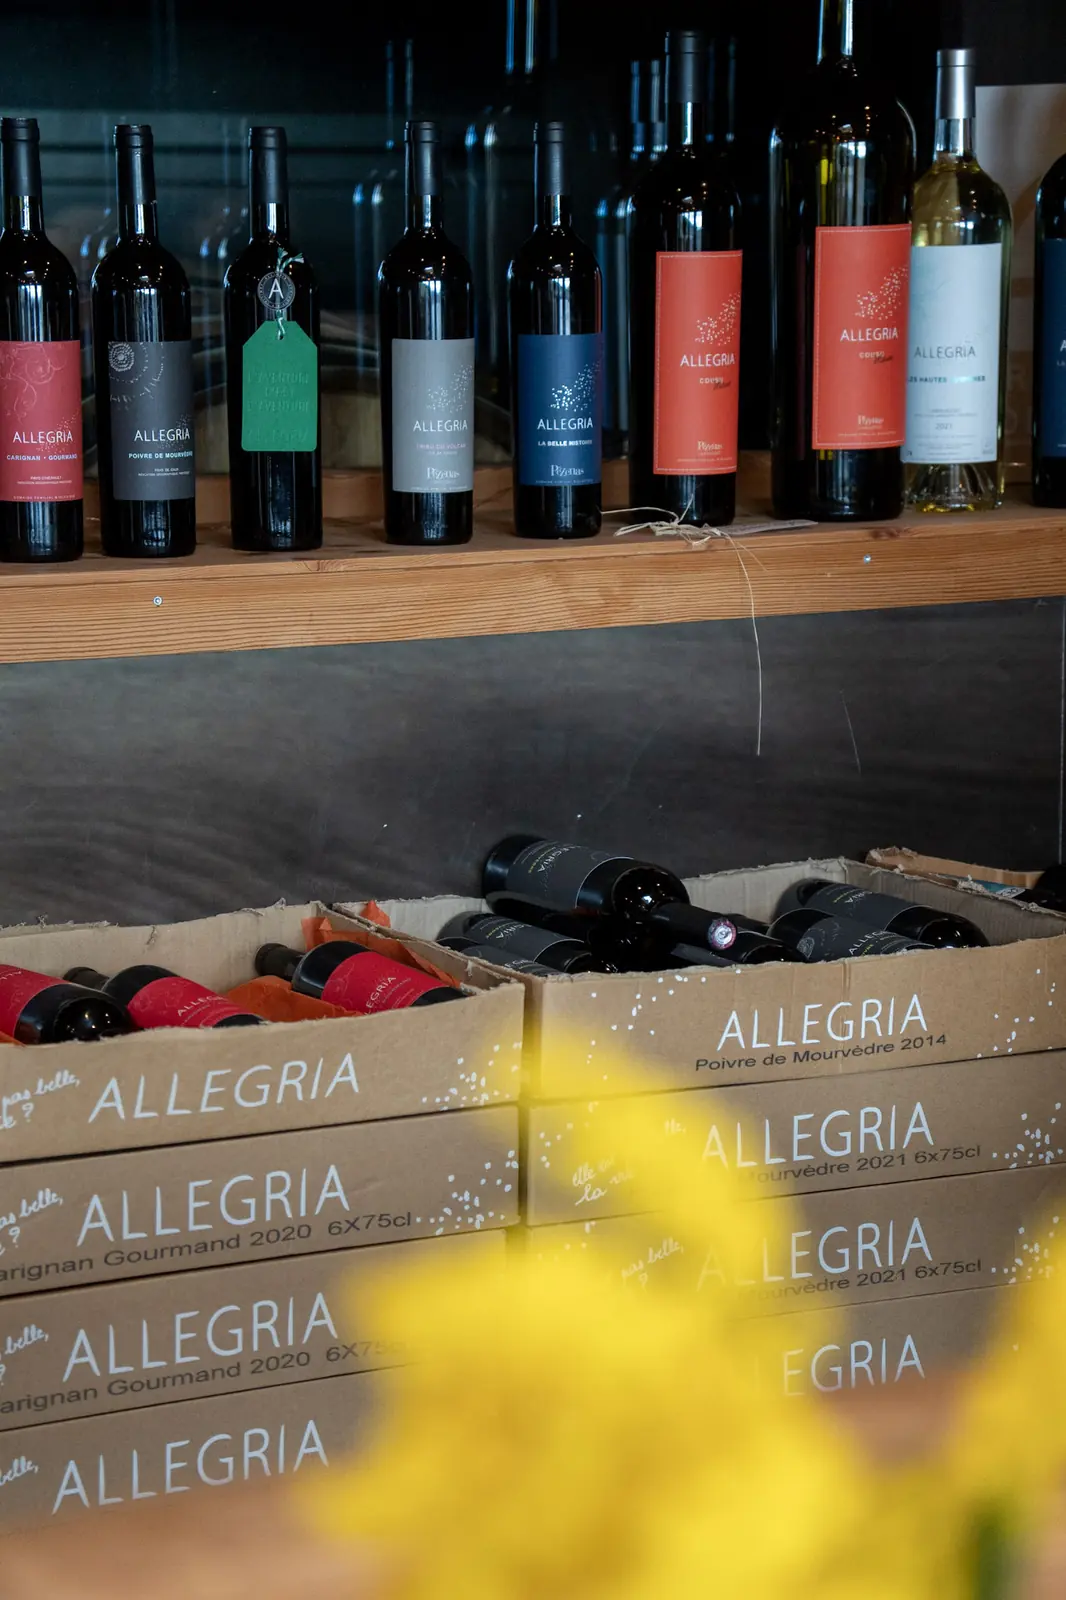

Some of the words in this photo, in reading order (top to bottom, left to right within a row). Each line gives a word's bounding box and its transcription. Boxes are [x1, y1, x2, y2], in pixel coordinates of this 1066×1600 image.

[268, 278, 284, 299] A
[840, 327, 899, 342] ALLEGRIA
[680, 353, 735, 367] ALLEGRIA
[914, 345, 976, 359] ALLEGRIA
[13, 430, 73, 444] ALLEGRIA
[134, 428, 191, 442] ALLEGRIA
[412, 420, 468, 432] ALLEGRIA
[537, 417, 593, 430] ALLEGRIA
[6, 453, 41, 461] CARIGNAN
[48, 453, 78, 461] GOURMAND
[717, 994, 928, 1051] ALLEGRIA
[695, 1055, 757, 1072] Poivre
[763, 1052, 787, 1067] de
[901, 1034, 947, 1050] 2014
[88, 1052, 360, 1124] ALLEGRIA
[701, 1101, 934, 1170] ALLEGRIA
[857, 1154, 906, 1172] 2021
[914, 1144, 981, 1165] 6x75cl
[76, 1164, 350, 1247] ALLEGRIA
[0, 1258, 93, 1281] arignan
[104, 1235, 240, 1267] Gourmand
[250, 1224, 312, 1248] 2020
[327, 1211, 412, 1237] 6X75cl
[857, 1269, 906, 1288] 2021
[914, 1258, 982, 1279] 6x75cl
[63, 1292, 338, 1382] ALLEGRIA
[0, 1387, 98, 1414] arignan
[107, 1361, 241, 1397] Gourmand
[250, 1351, 311, 1375] 2020
[326, 1340, 400, 1363] 6X75
[51, 1419, 329, 1515] ALLEGRIA
